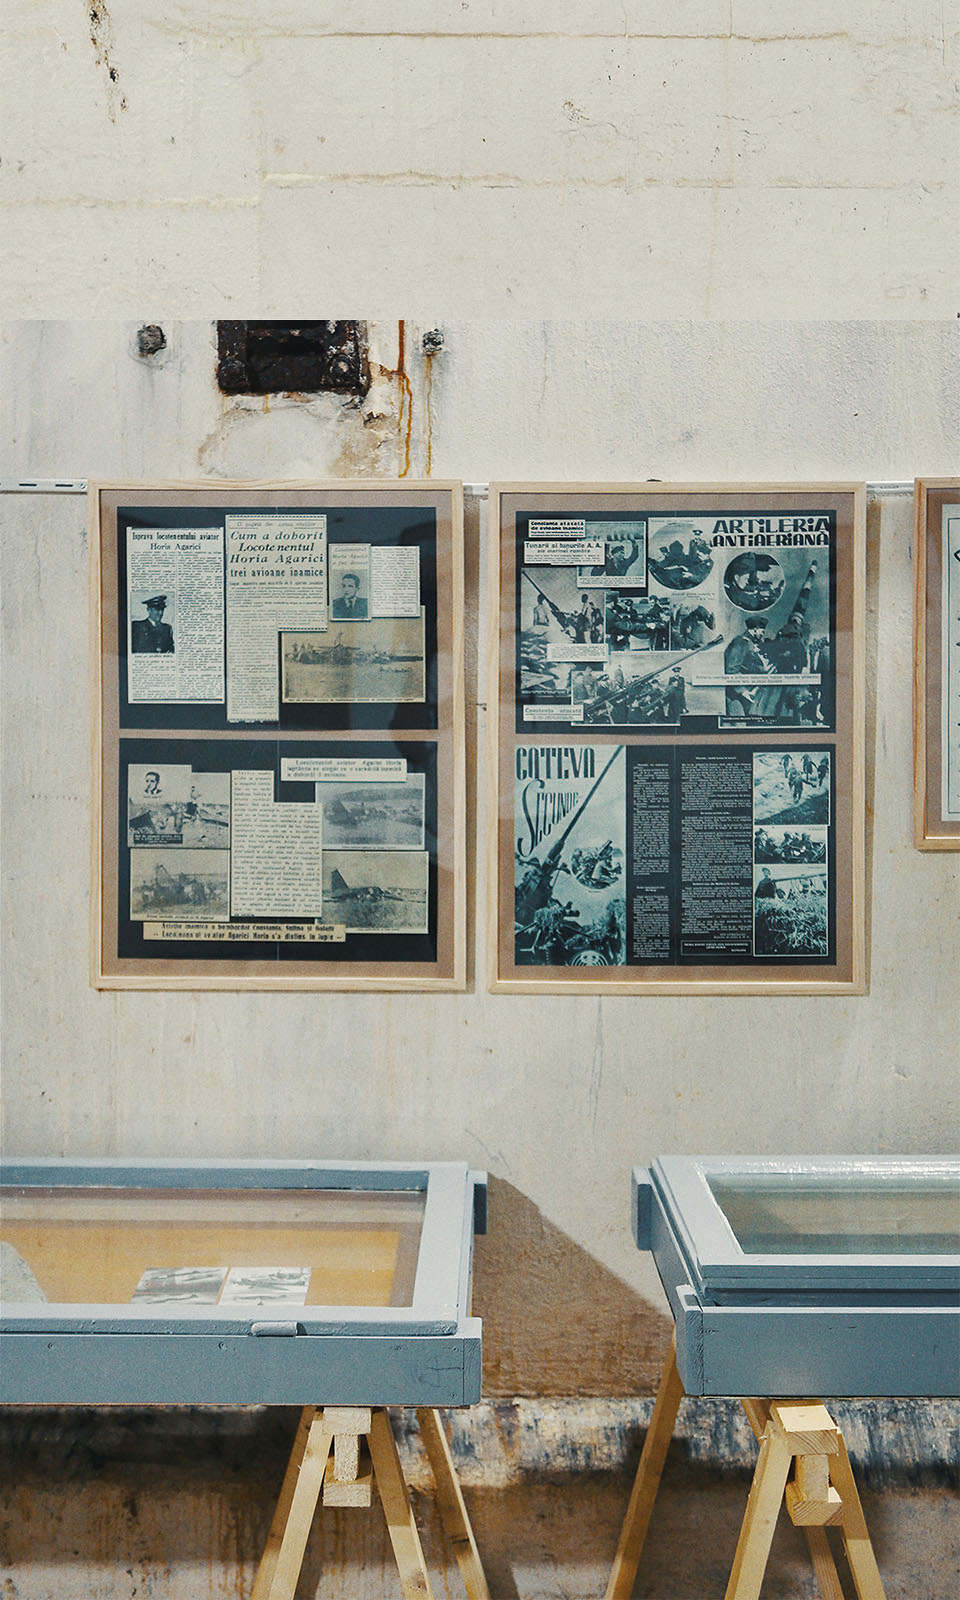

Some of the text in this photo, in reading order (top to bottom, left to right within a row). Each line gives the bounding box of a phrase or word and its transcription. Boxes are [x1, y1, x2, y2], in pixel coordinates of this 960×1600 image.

[230, 531, 257, 540] Cum
[176, 543, 201, 551] Agarici
[230, 553, 324, 565] Horia Agarici
[230, 567, 324, 577] trei avioane inamice
